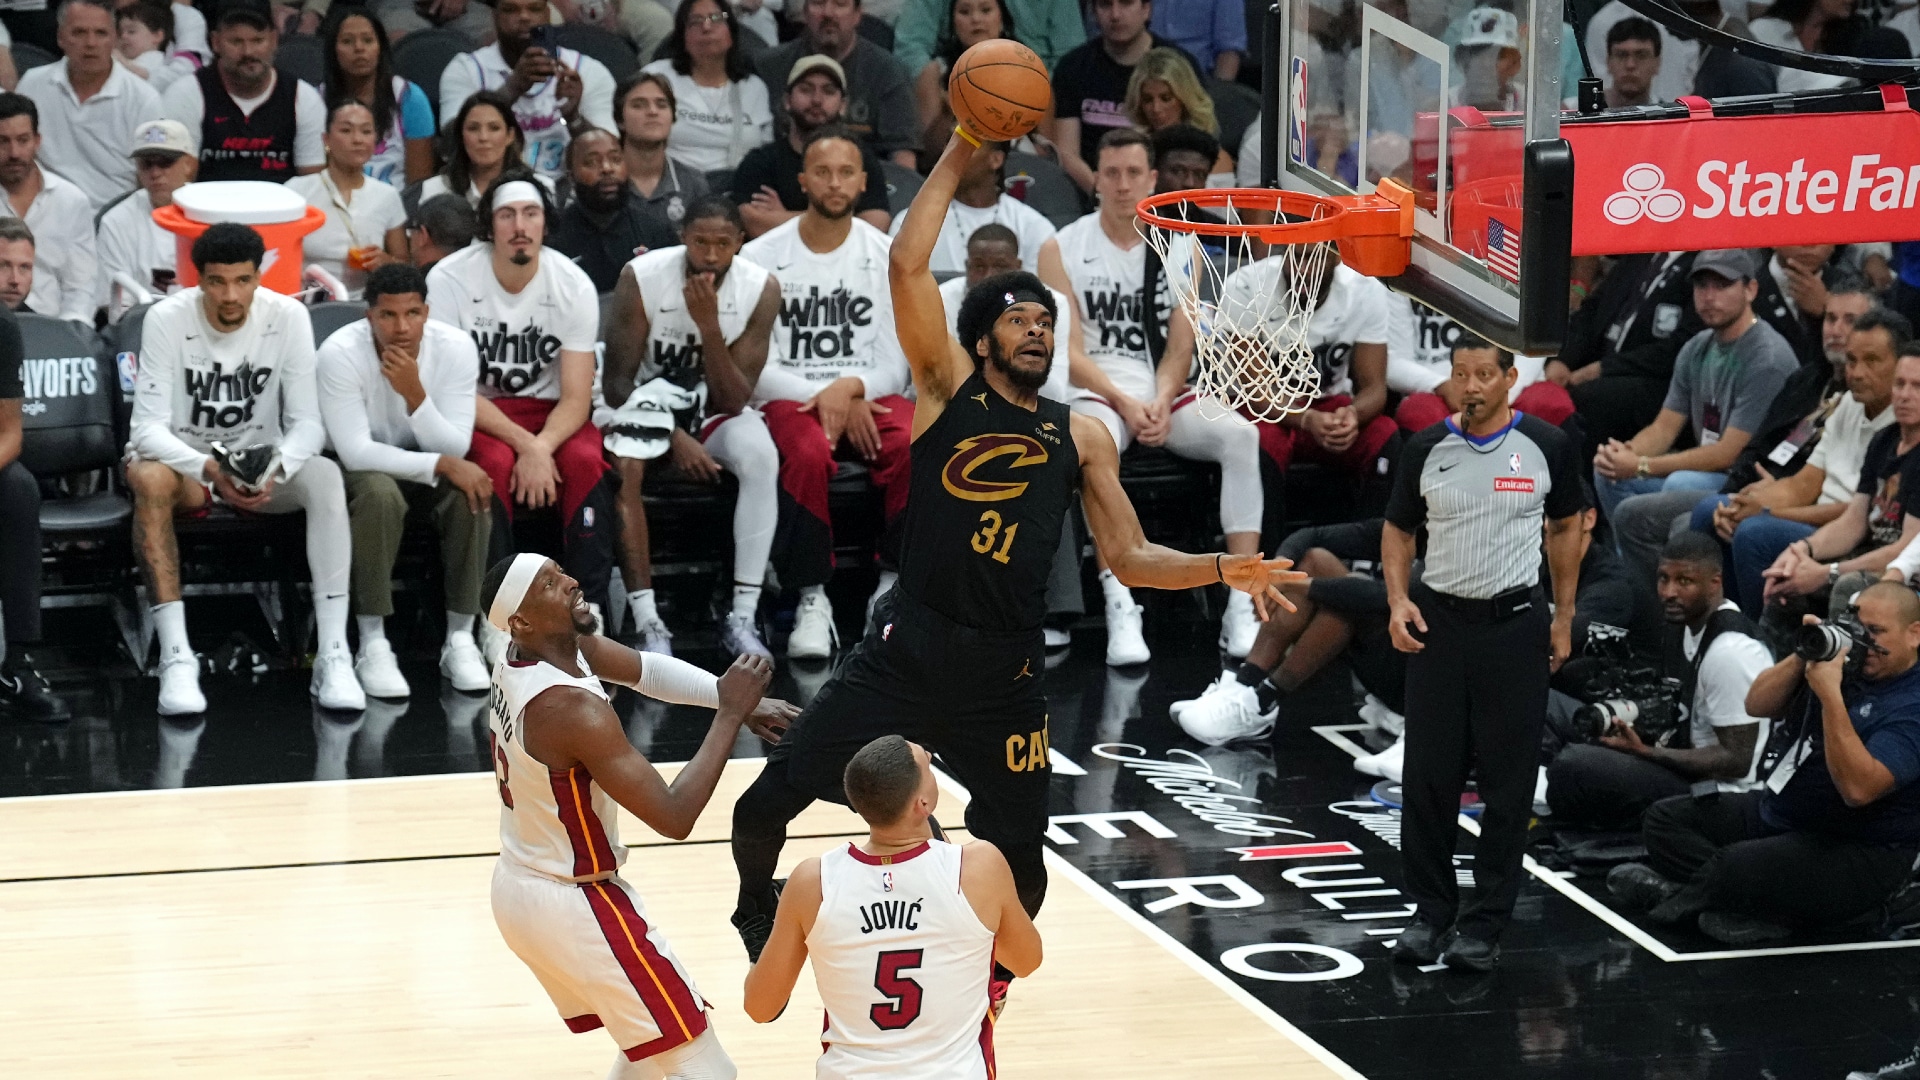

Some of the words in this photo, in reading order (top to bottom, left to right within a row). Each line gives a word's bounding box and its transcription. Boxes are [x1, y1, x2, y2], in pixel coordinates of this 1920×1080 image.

[1692, 157, 1839, 219] State
[779, 279, 873, 327] white
[1084, 281, 1144, 322] whi
[471, 316, 563, 364] white
[790, 319, 854, 360] hot
[1096, 309, 1146, 352] ho
[1419, 306, 1464, 349] ho
[18, 356, 98, 399] AYOFFS
[184, 355, 273, 402] white
[21, 400, 47, 416] ogle
[191, 391, 256, 428] hot
[1035, 427, 1061, 445] CLIFFS
[1495, 479, 1535, 490] Emirates
[970, 509, 1019, 565] 31
[490, 681, 513, 744] DEBAYO
[1091, 742, 1316, 838] Michelob
[1281, 863, 1450, 974] ULT
[859, 897, 924, 934] JOVIĆ
[869, 948, 924, 1031] 5
